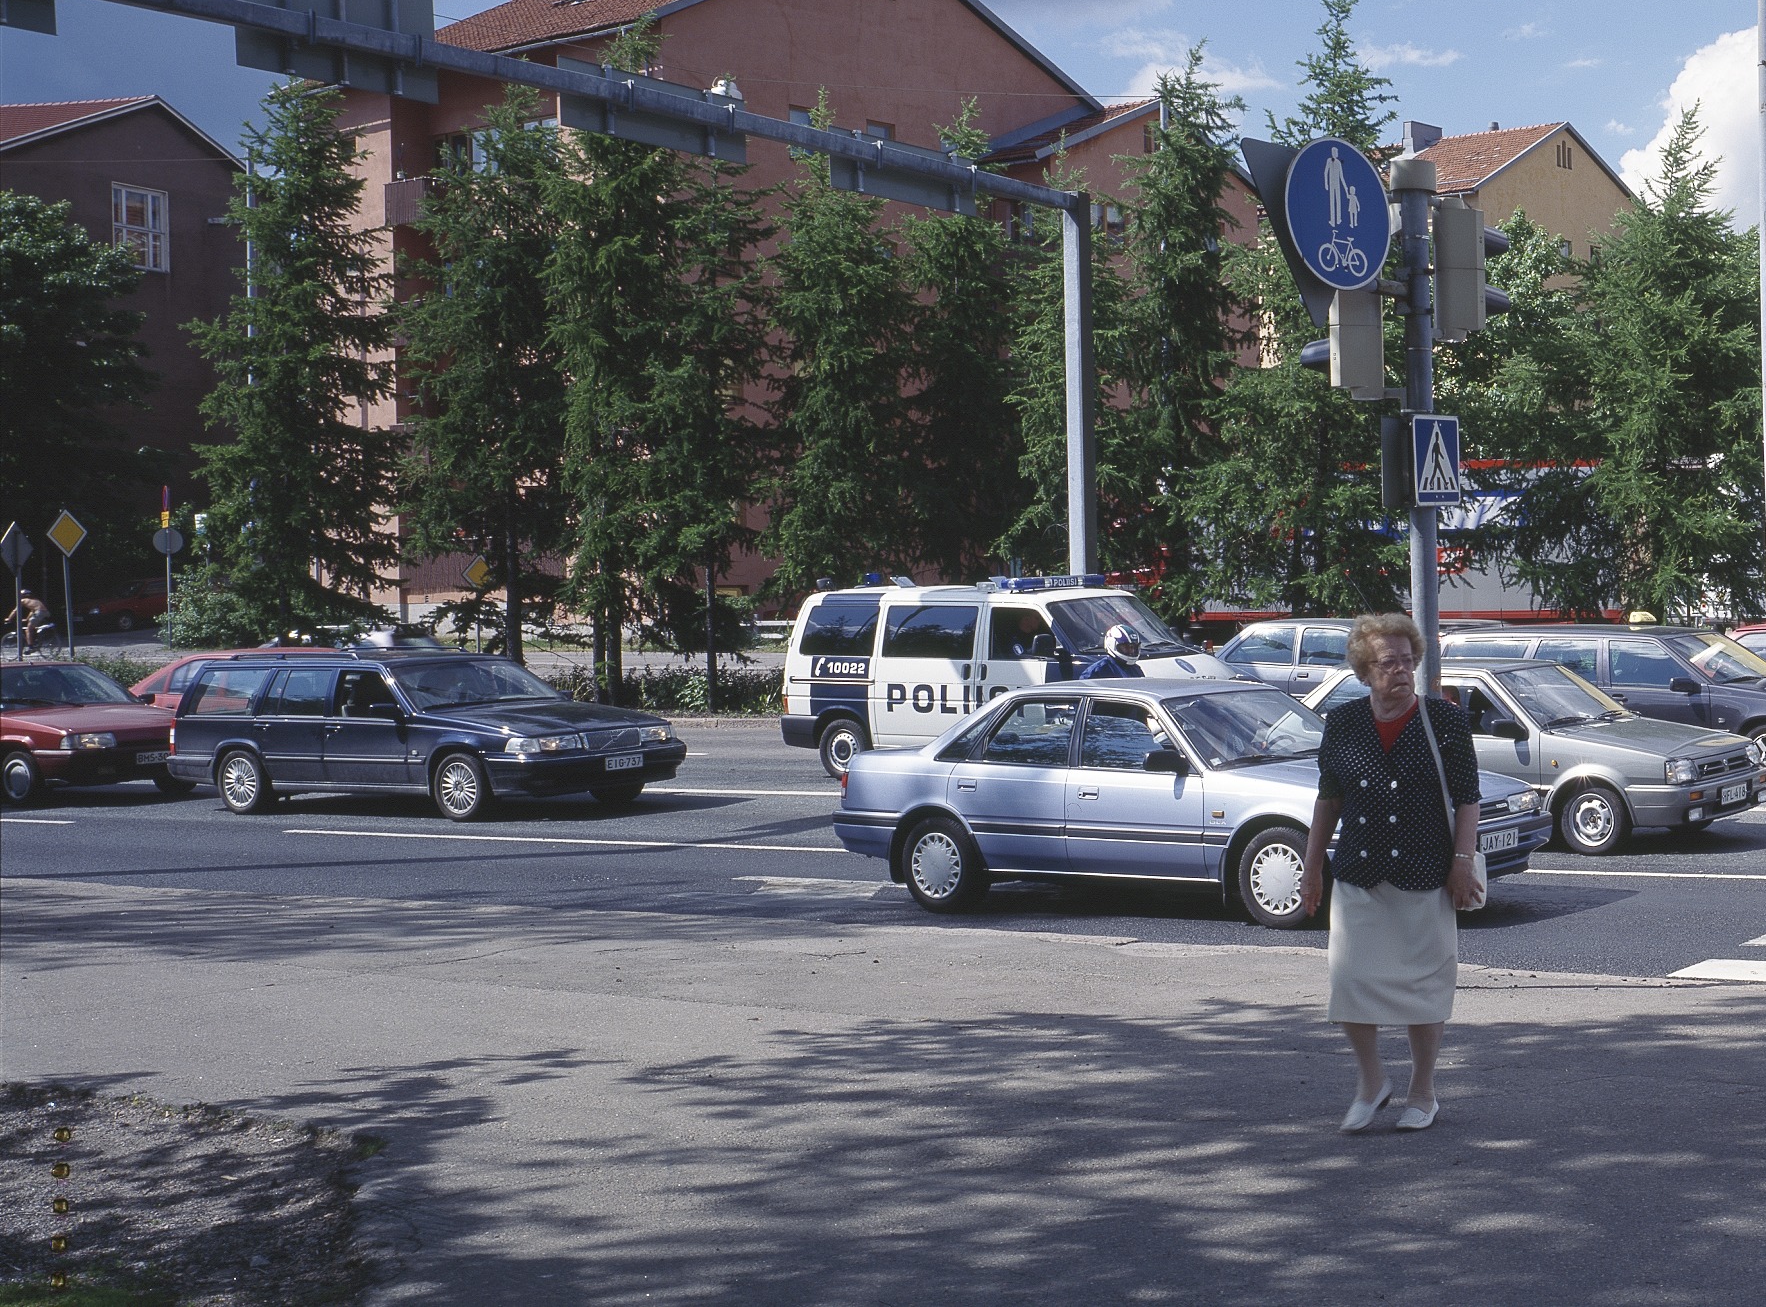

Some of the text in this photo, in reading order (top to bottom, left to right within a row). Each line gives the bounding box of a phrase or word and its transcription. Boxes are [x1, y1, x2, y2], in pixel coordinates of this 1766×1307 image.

[1053, 578, 1077, 587] POLIISI
[826, 662, 866, 675] 10022
[138, 753, 171, 763] BMS-30
